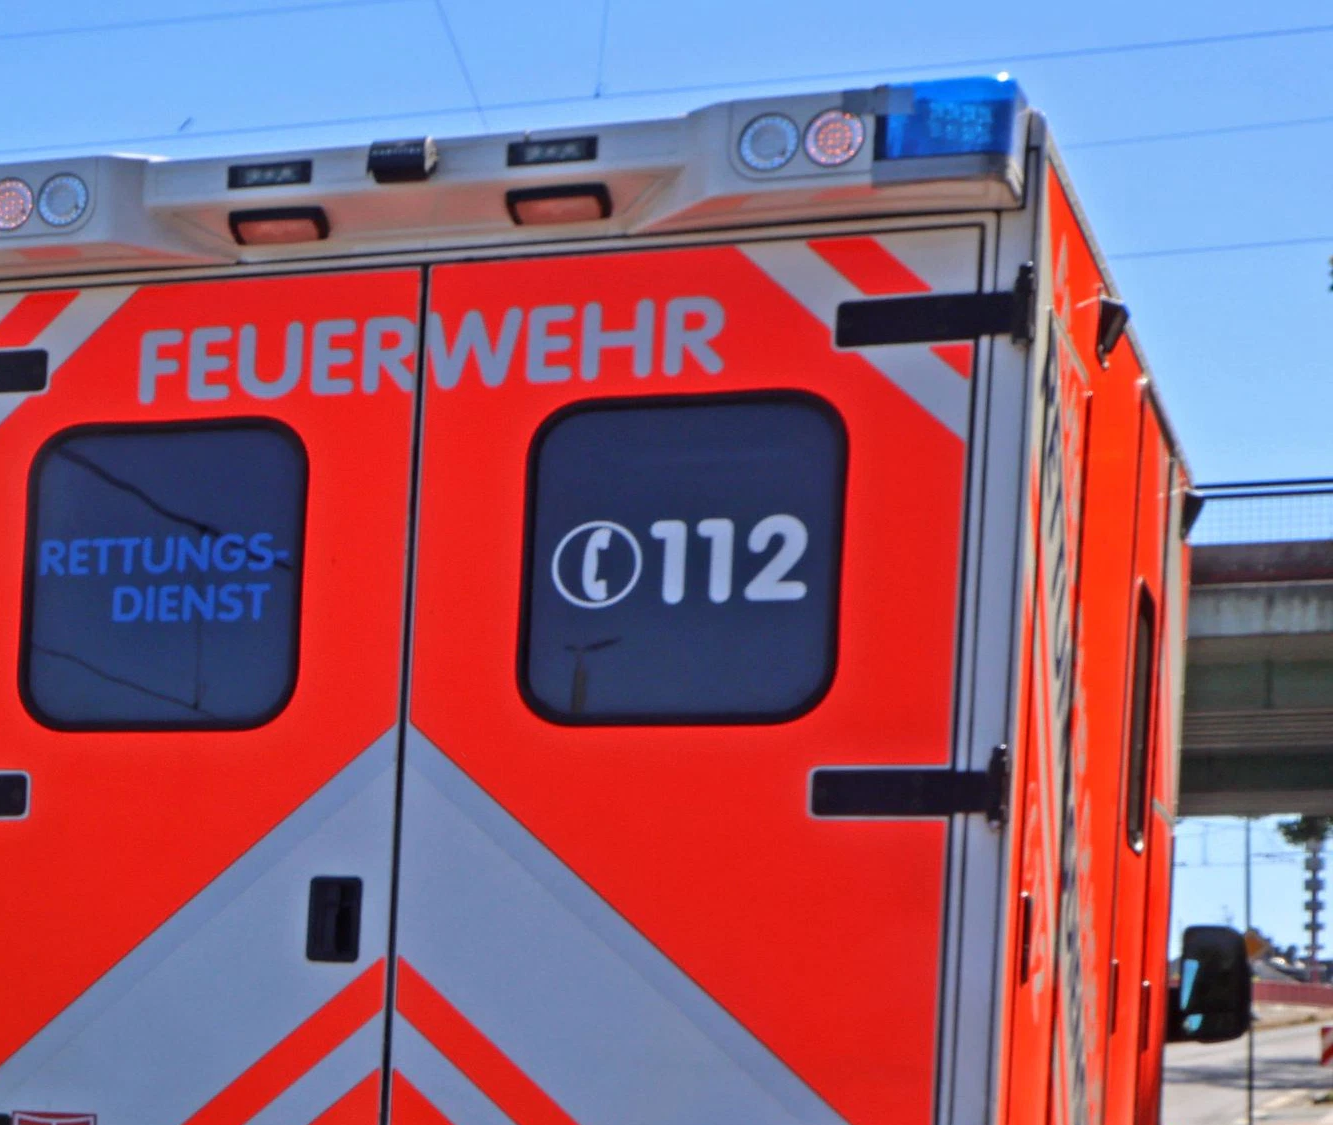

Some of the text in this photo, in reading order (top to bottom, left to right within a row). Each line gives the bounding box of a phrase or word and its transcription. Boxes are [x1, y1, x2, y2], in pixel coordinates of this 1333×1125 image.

[138, 296, 724, 403] FEUERWEHR
[39, 533, 290, 576] RETTUNGS-
[651, 514, 810, 603] 112
[112, 584, 270, 622] DIENST
